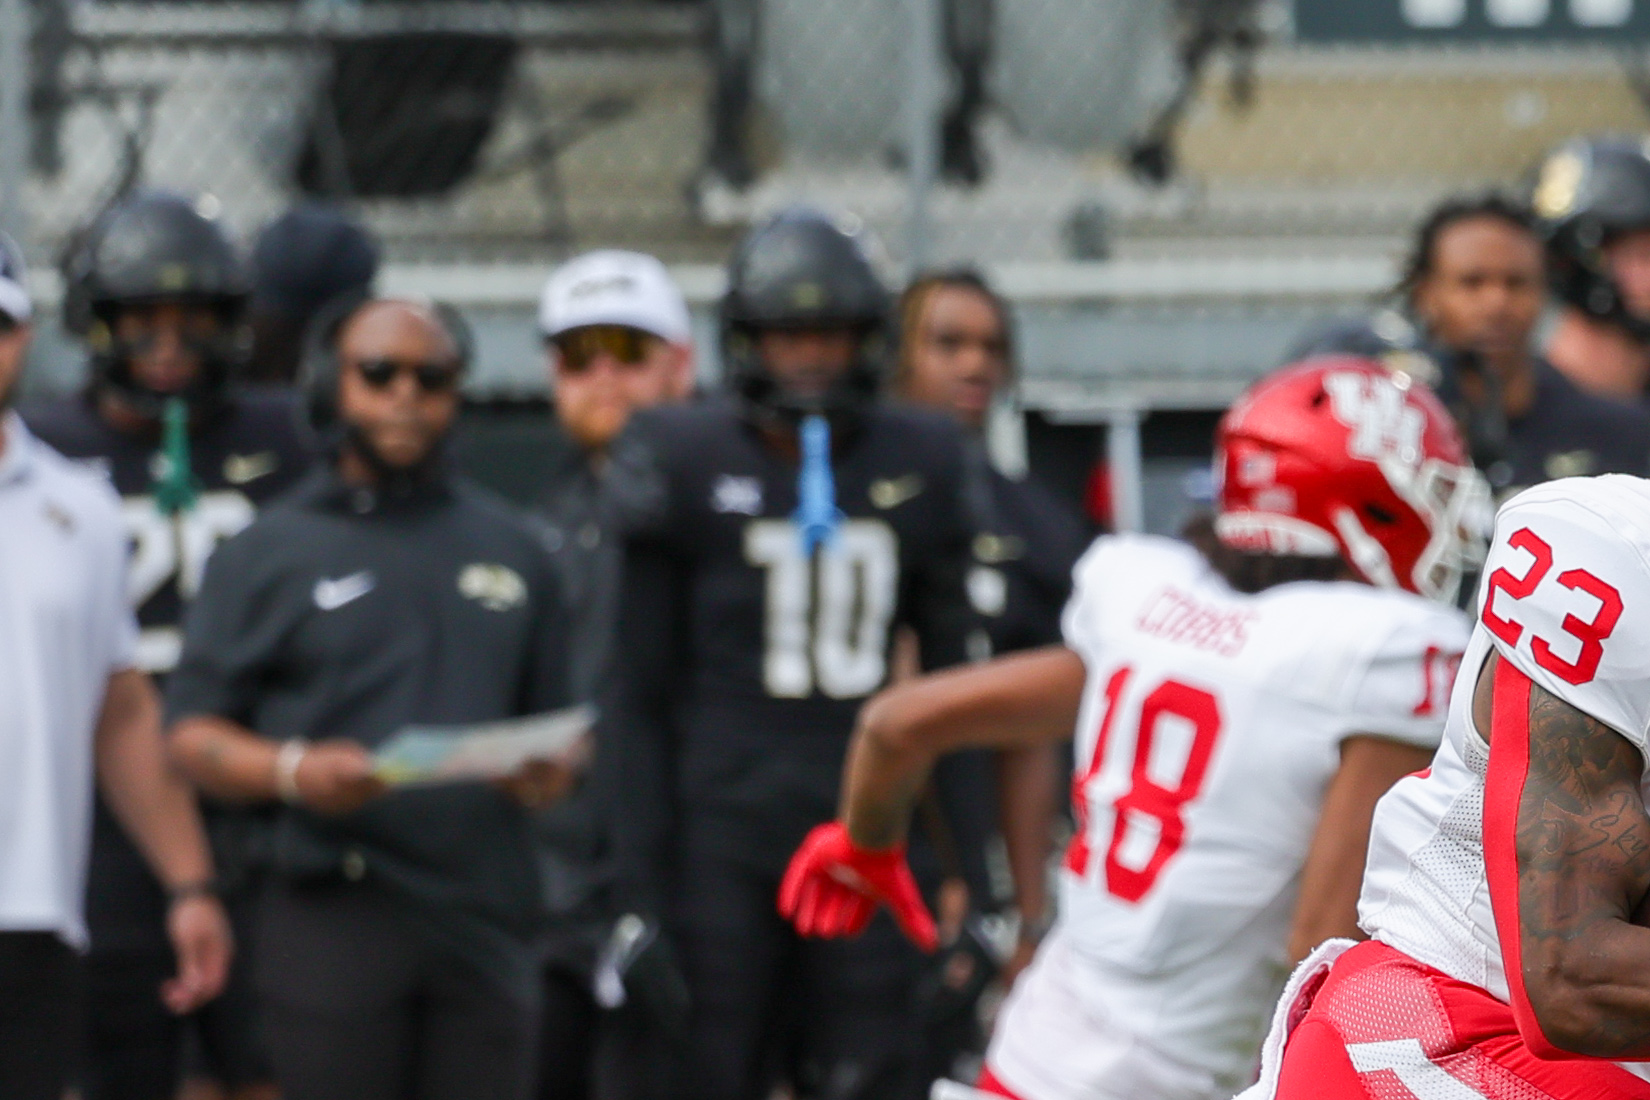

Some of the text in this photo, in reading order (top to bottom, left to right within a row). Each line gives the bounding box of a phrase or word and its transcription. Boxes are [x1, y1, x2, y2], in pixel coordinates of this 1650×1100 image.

[742, 517, 899, 698] 10
[1482, 527, 1625, 686] 23
[1062, 666, 1223, 904] 18
